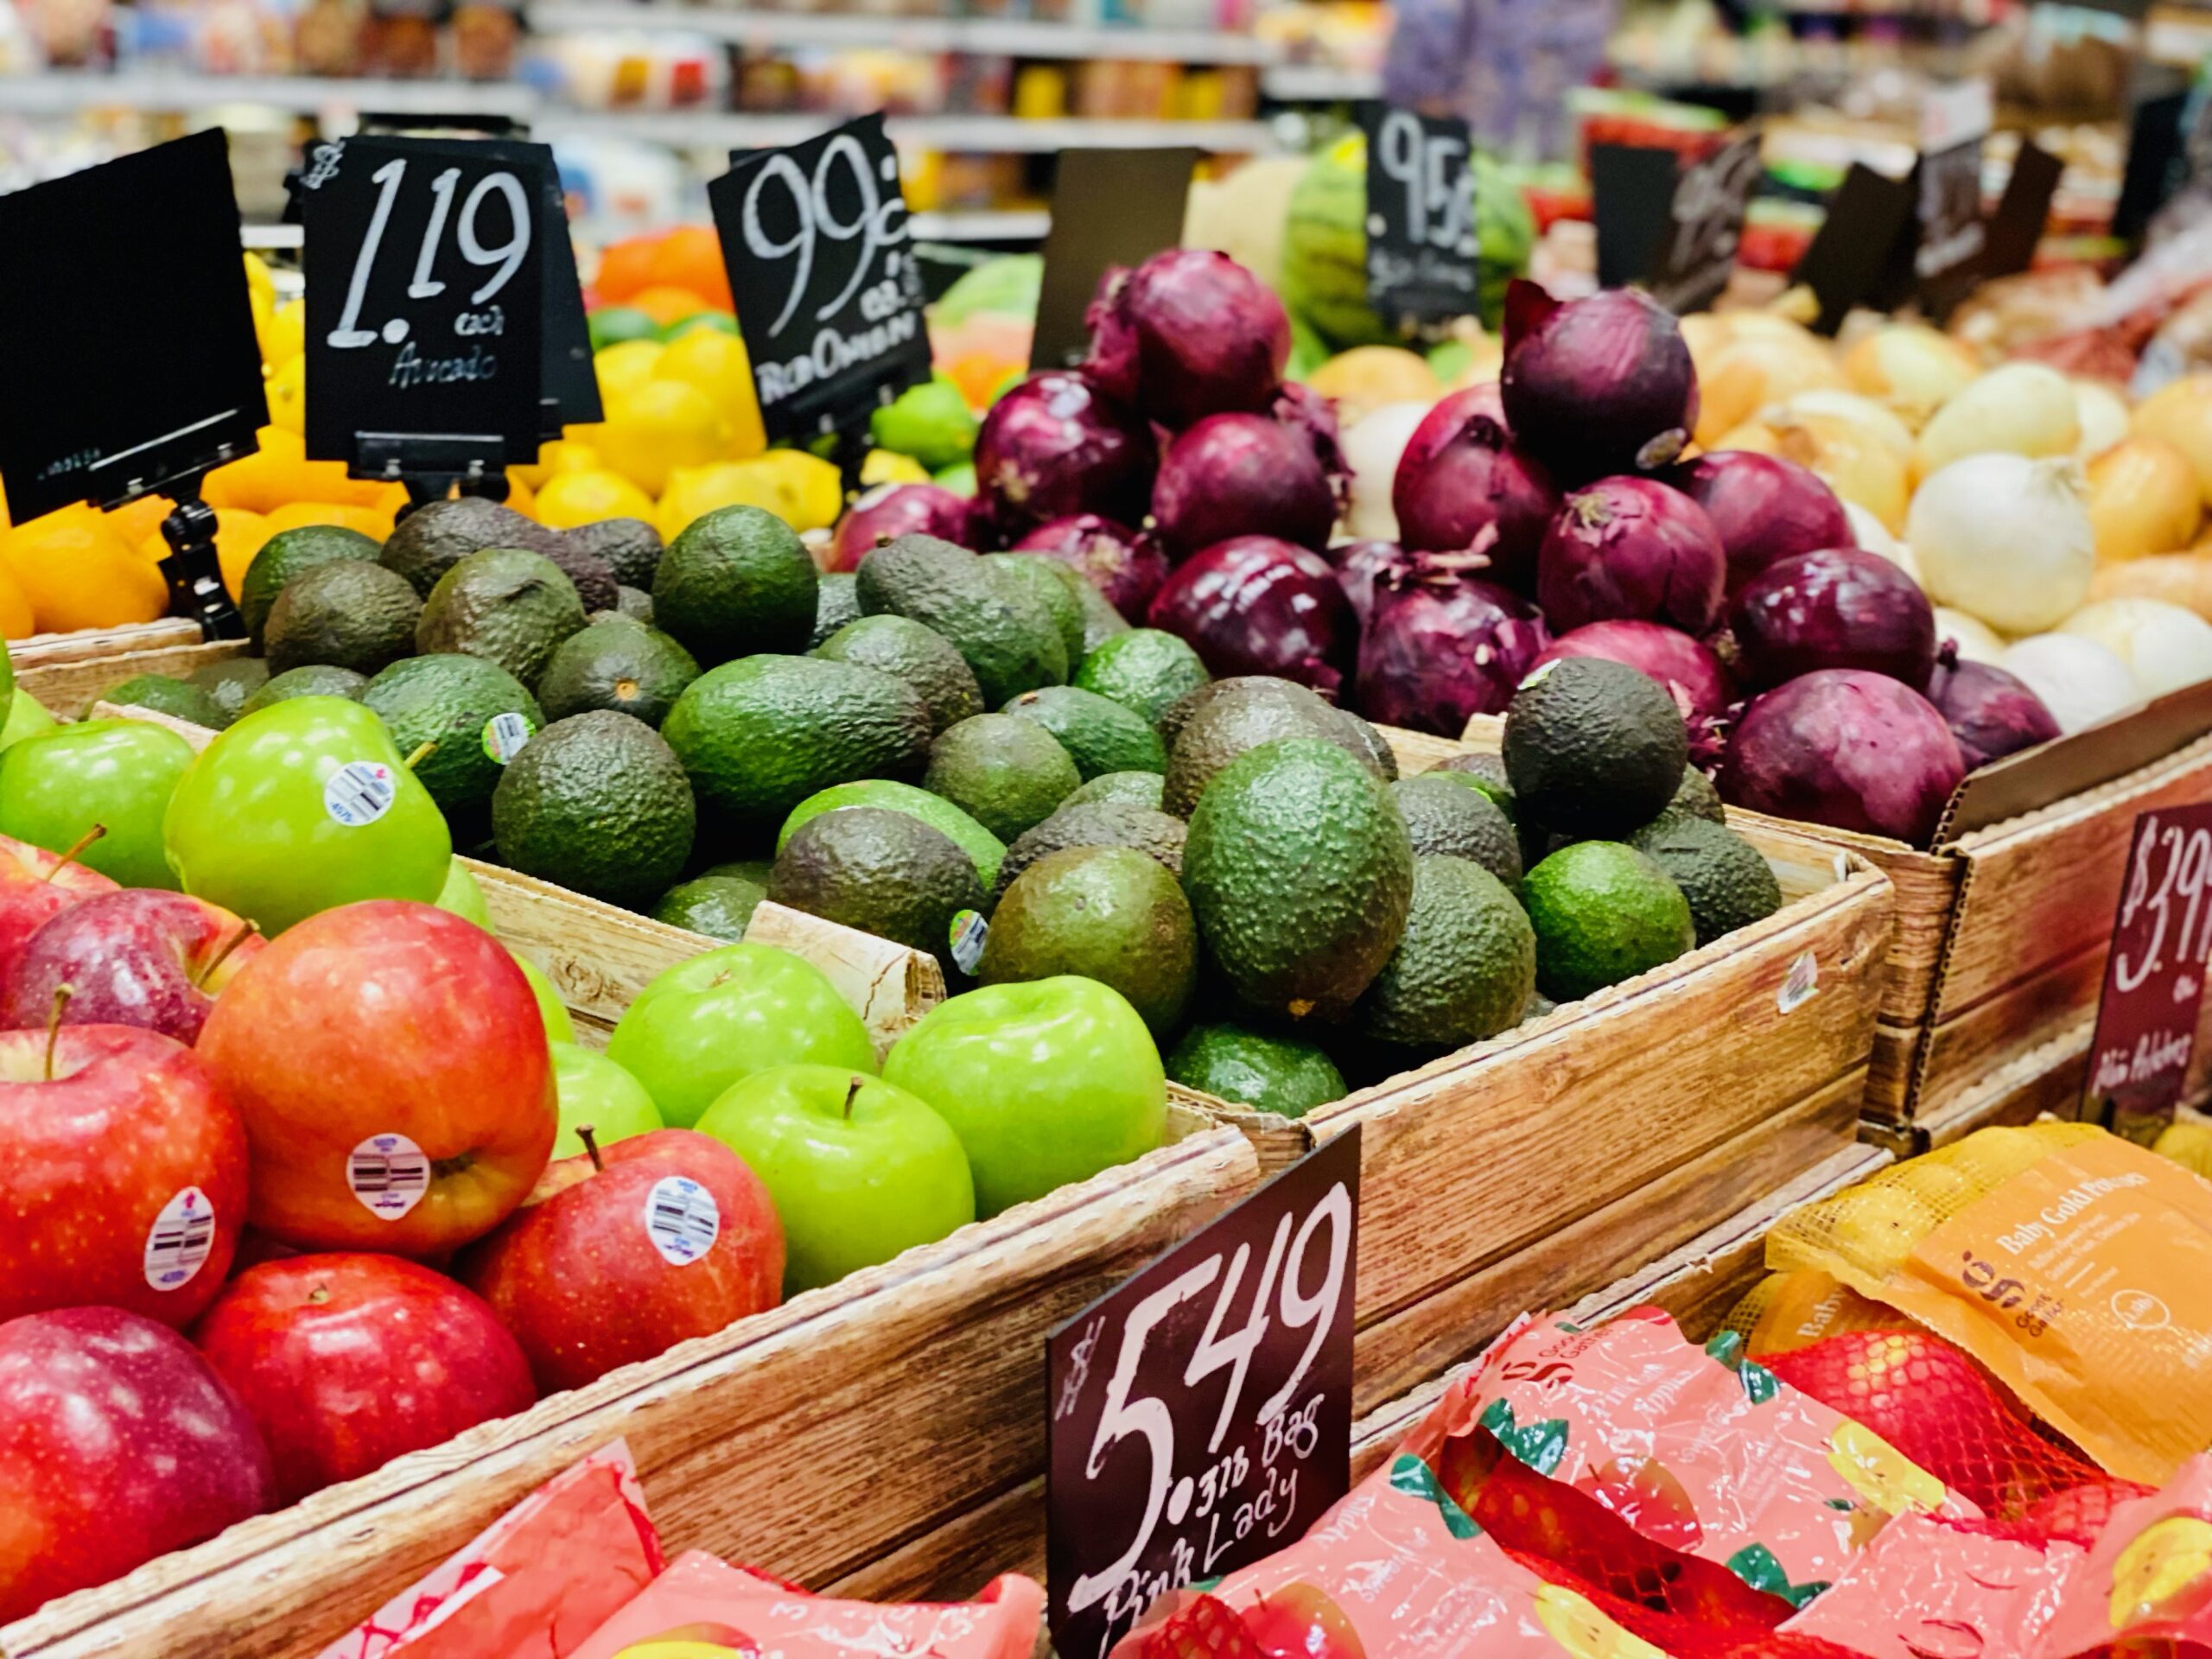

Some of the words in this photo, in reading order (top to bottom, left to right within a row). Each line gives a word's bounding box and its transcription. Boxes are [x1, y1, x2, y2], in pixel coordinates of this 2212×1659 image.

[327, 158, 531, 348] 1.19
[1996, 1222, 2056, 1255] Baby
[2040, 1188, 2094, 1225] Gold
[1068, 1181, 1352, 1613] 5.49
[1262, 1393, 1325, 1468] Bag
[1098, 1537, 1196, 1659] Pink
[1203, 1466, 1299, 1574] Lady
